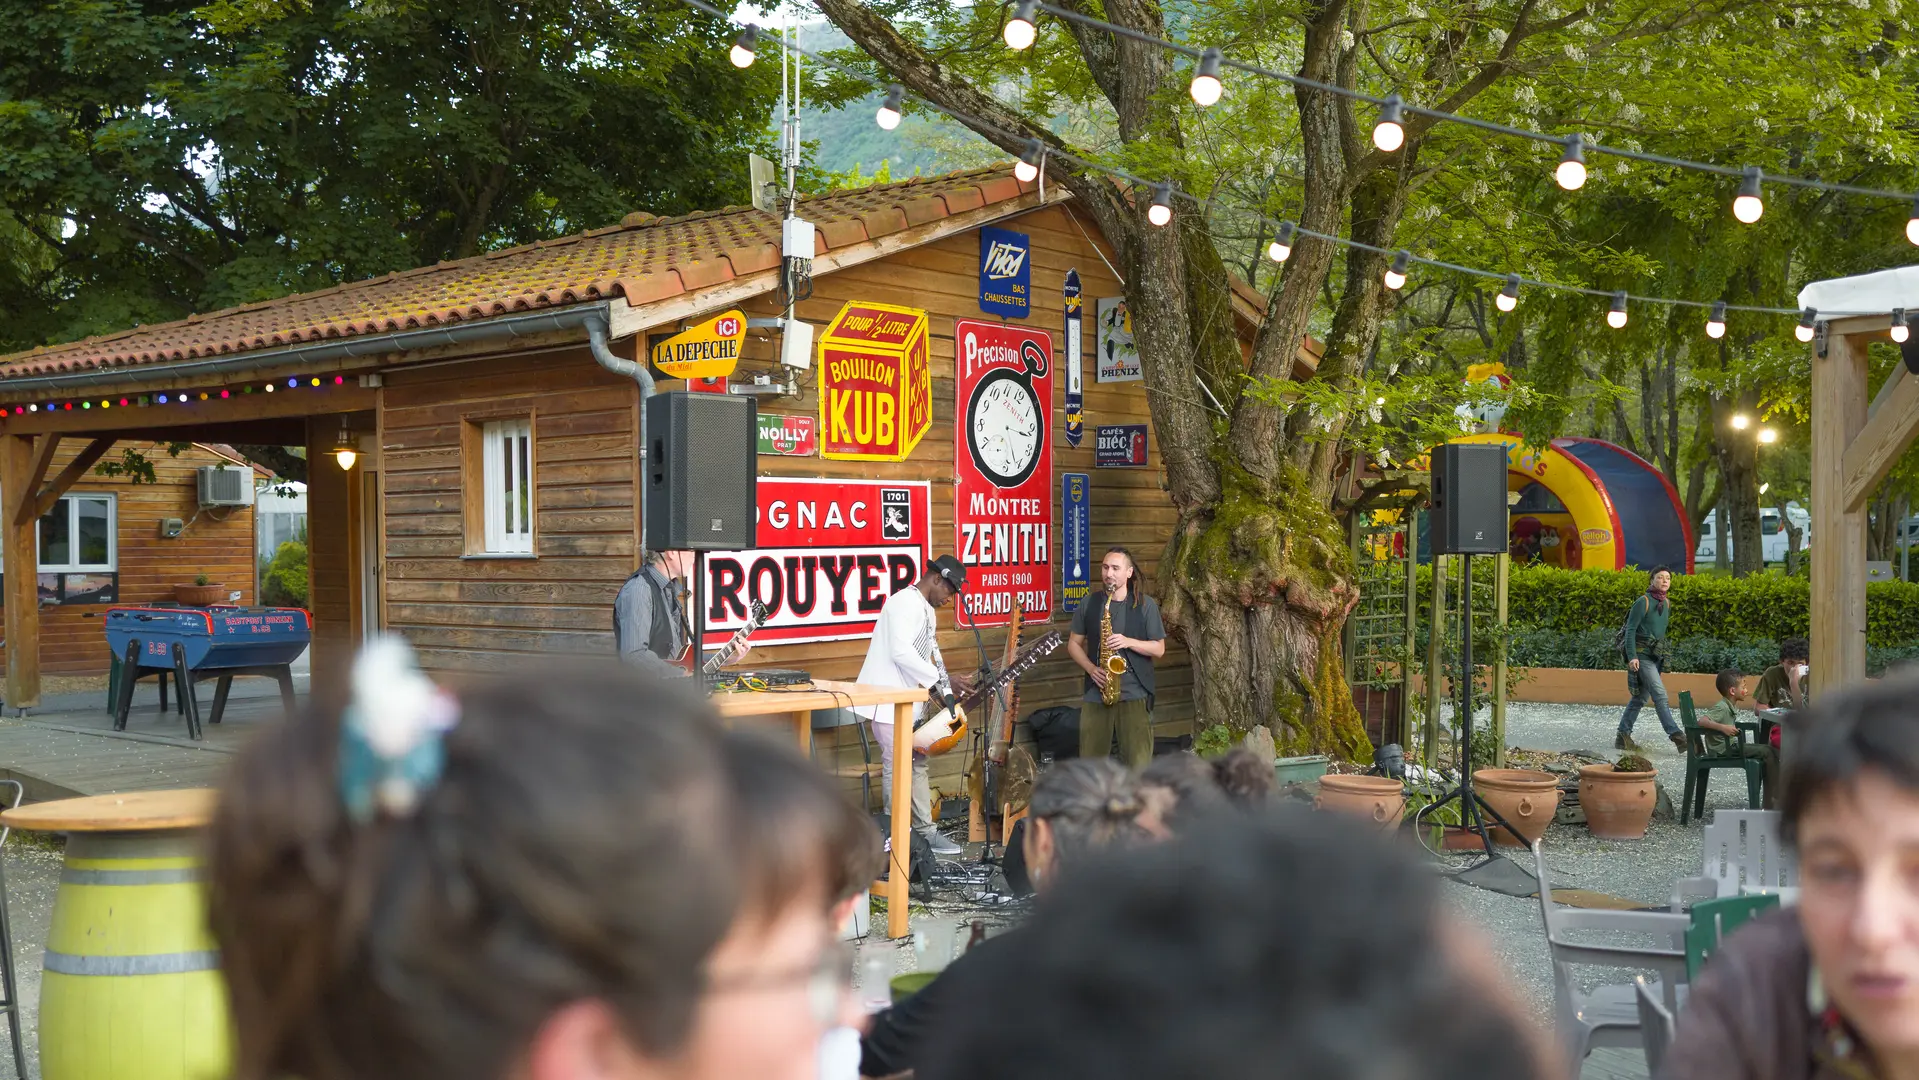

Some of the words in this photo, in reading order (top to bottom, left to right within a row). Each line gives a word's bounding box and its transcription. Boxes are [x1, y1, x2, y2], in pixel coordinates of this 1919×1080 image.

[1012, 284, 1025, 294] BAS
[984, 292, 1027, 307] CHAUSSETTES
[842, 315, 874, 331] POUR
[881, 320, 910, 336] LITRE
[656, 344, 674, 363] LA
[676, 339, 737, 361] DÉPÊCHE
[964, 332, 1019, 379] Précision
[677, 362, 692, 372] Midi
[830, 358, 895, 388] BOUILLON
[1101, 368, 1139, 377] PHENIX
[989, 384, 1000, 402] 10
[1002, 382, 1011, 398] 11
[1014, 387, 1025, 405] 12
[982, 399, 990, 415] 9
[1002, 399, 1024, 425] ZENITH
[830, 388, 895, 446] KUB
[976, 418, 985, 433] 8
[1027, 422, 1036, 437] 2
[760, 427, 808, 442] NOILLY
[1025, 443, 1033, 457] 3
[1015, 457, 1023, 470] 4
[886, 492, 906, 501] 1701
[969, 492, 1041, 516] MONTRE
[757, 500, 867, 529] GNAC
[961, 523, 1049, 567] ZENITH
[982, 573, 1008, 587] PARIS
[1011, 572, 1032, 585] 1900
[1064, 587, 1089, 598] PHILIPS
[964, 591, 1012, 617] GRAND
[1017, 590, 1048, 612] PRIX
